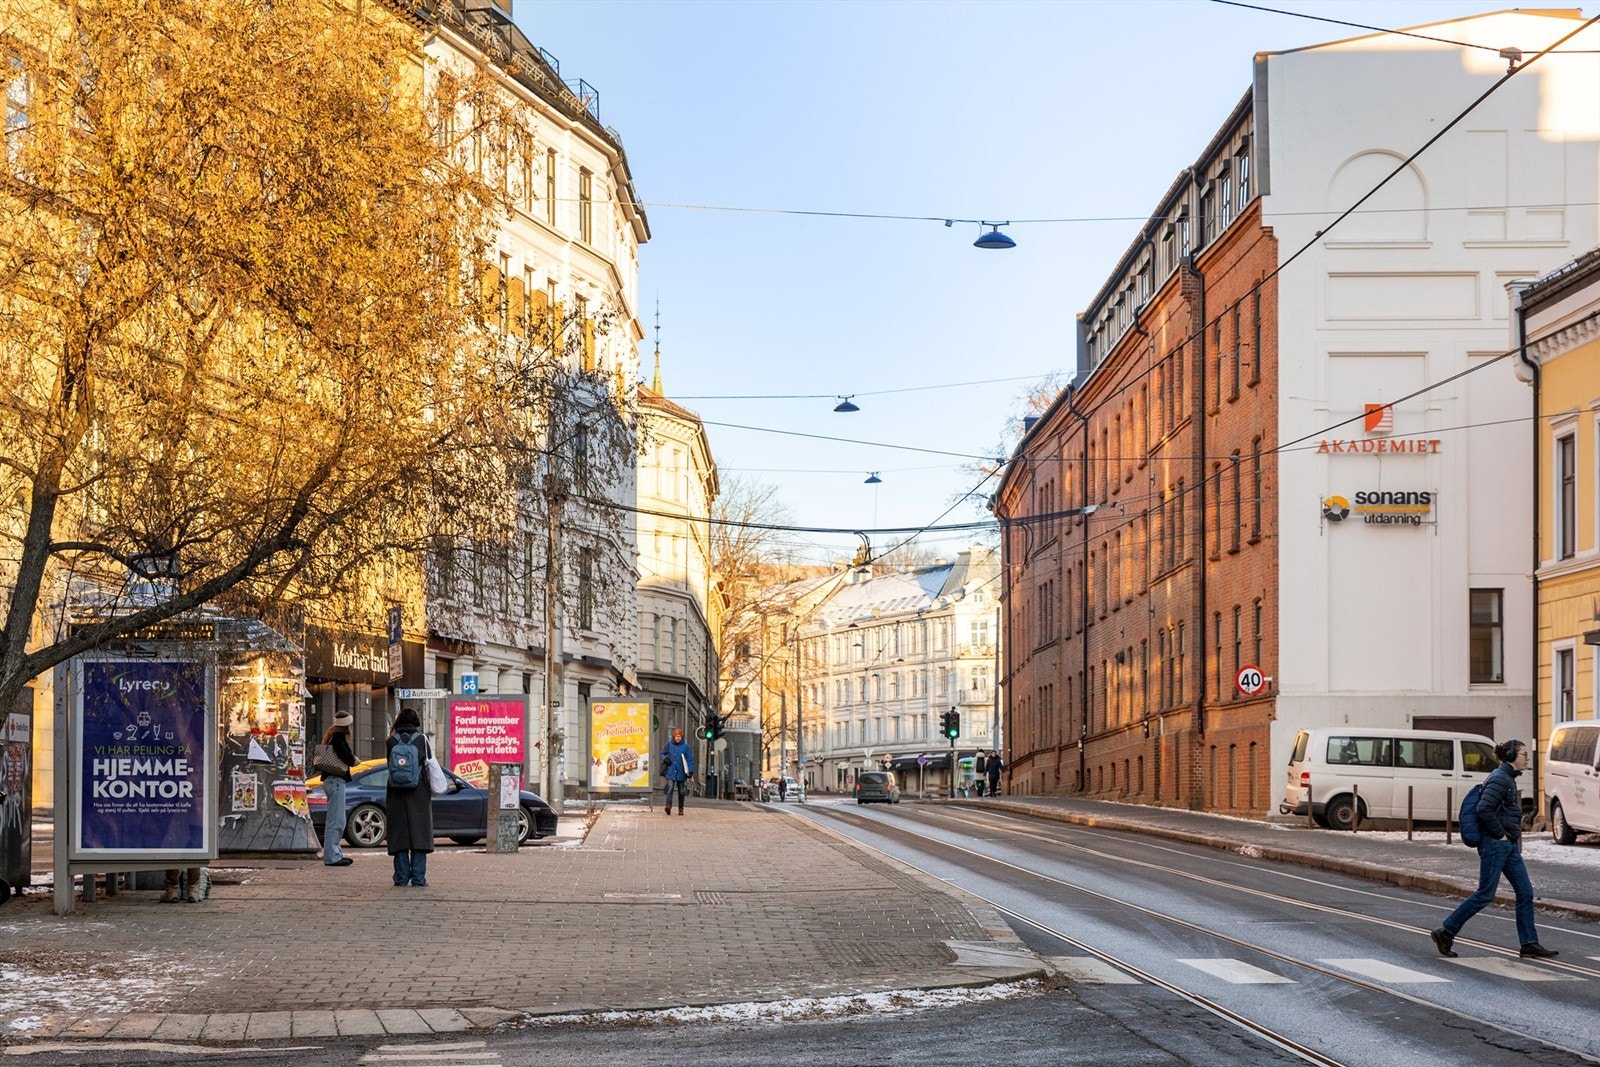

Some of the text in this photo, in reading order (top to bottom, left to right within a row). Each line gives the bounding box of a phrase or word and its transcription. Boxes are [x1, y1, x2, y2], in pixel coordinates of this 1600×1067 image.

[1317, 439, 1440, 453] AKADEMIET
[1355, 491, 1431, 505] sonans
[1364, 513, 1421, 526] utdanning
[333, 641, 369, 671] Mother
[119, 678, 170, 693] Lyreco
[1241, 672, 1261, 687] 40
[455, 716, 520, 725] Fordi november
[455, 726, 507, 735] leverer 50%
[455, 736, 520, 746] mindre dagslys,
[94, 743, 192, 755] VI HAR PEILING PÅ
[455, 745, 518, 755] leverer vi dette
[93, 758, 194, 781] HJEMME-
[460, 761, 483, 774] 50%
[93, 780, 194, 798] KONTOR
